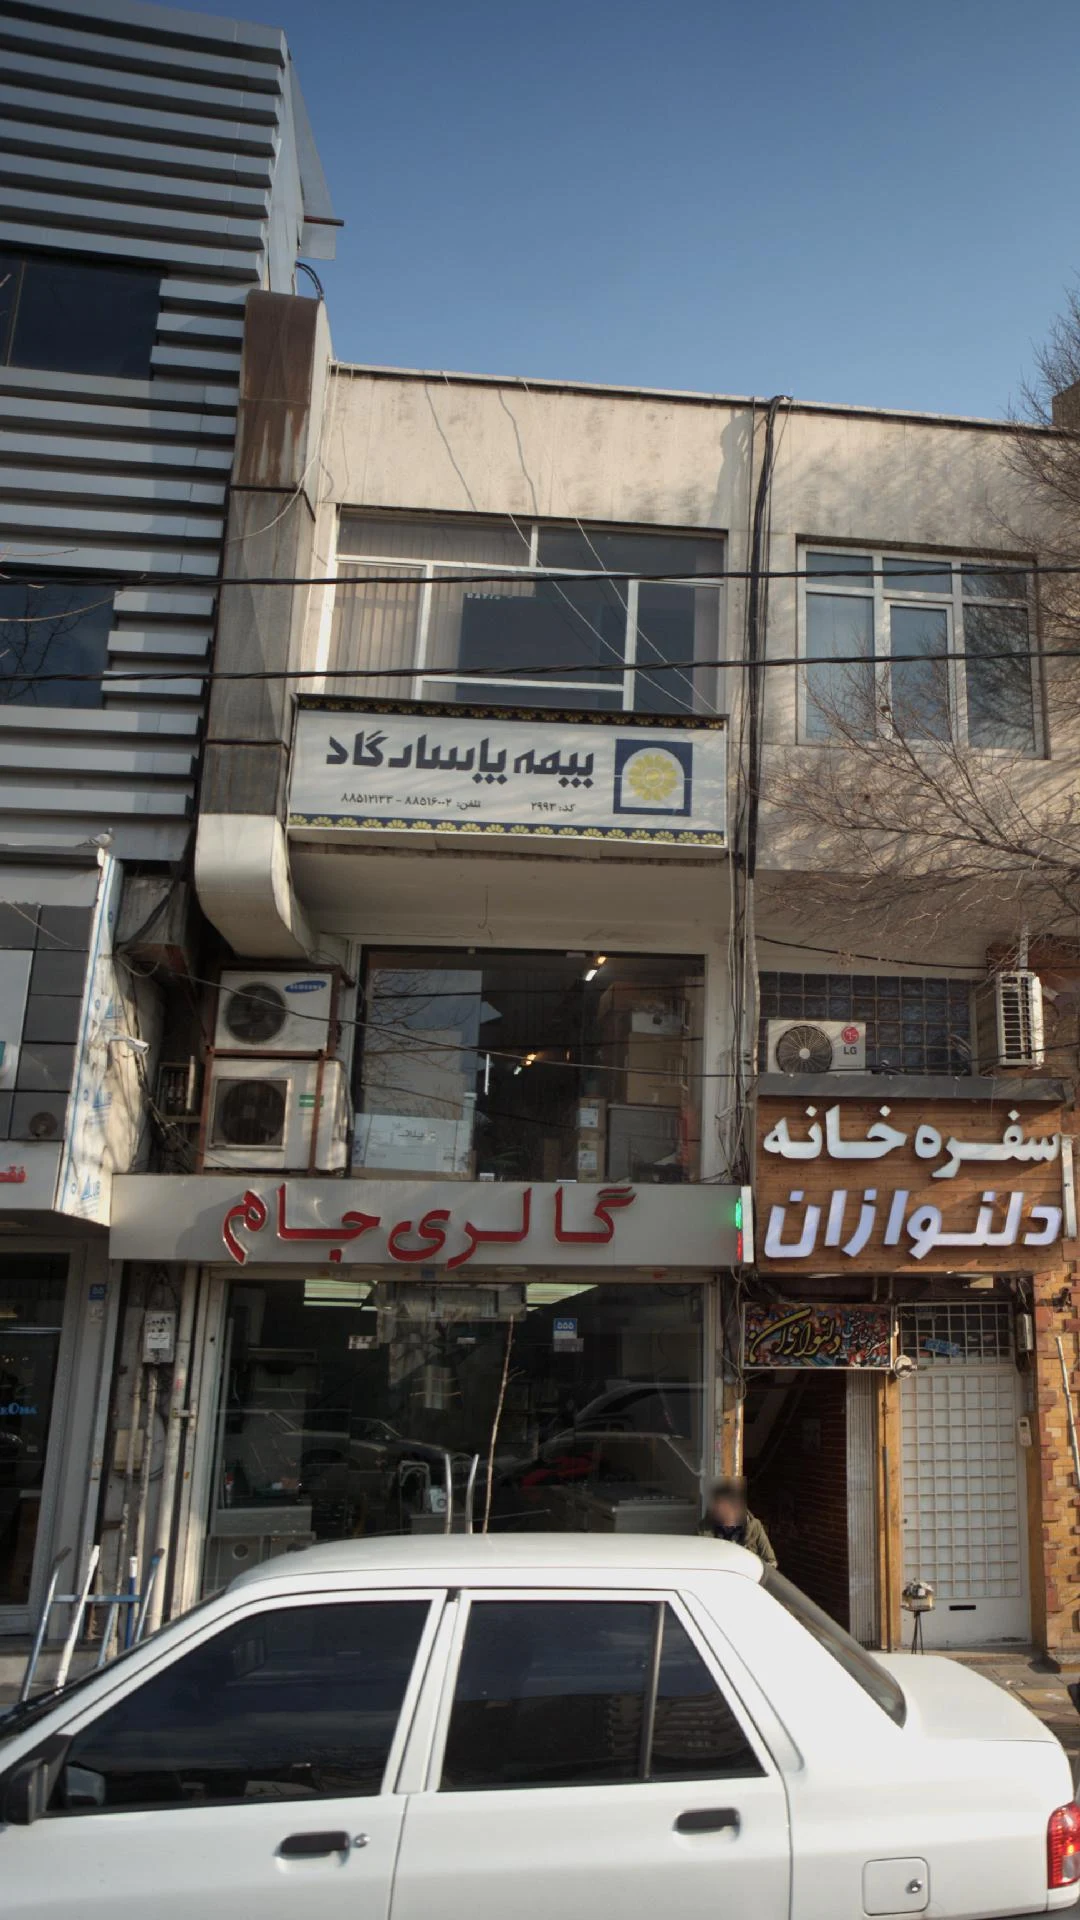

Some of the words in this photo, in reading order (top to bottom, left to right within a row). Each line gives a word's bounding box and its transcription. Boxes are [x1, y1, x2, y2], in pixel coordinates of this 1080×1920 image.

[325, 730, 508, 785] پاسارگاد
[513, 748, 595, 789] بیمه
[843, 1046, 857, 1055] LG
[762, 1104, 908, 1160] خانه
[913, 1109, 1061, 1178] سفره
[222, 1182, 382, 1265] جام
[386, 1185, 637, 1270] گالری
[763, 1189, 1063, 1260] دلنوازان
